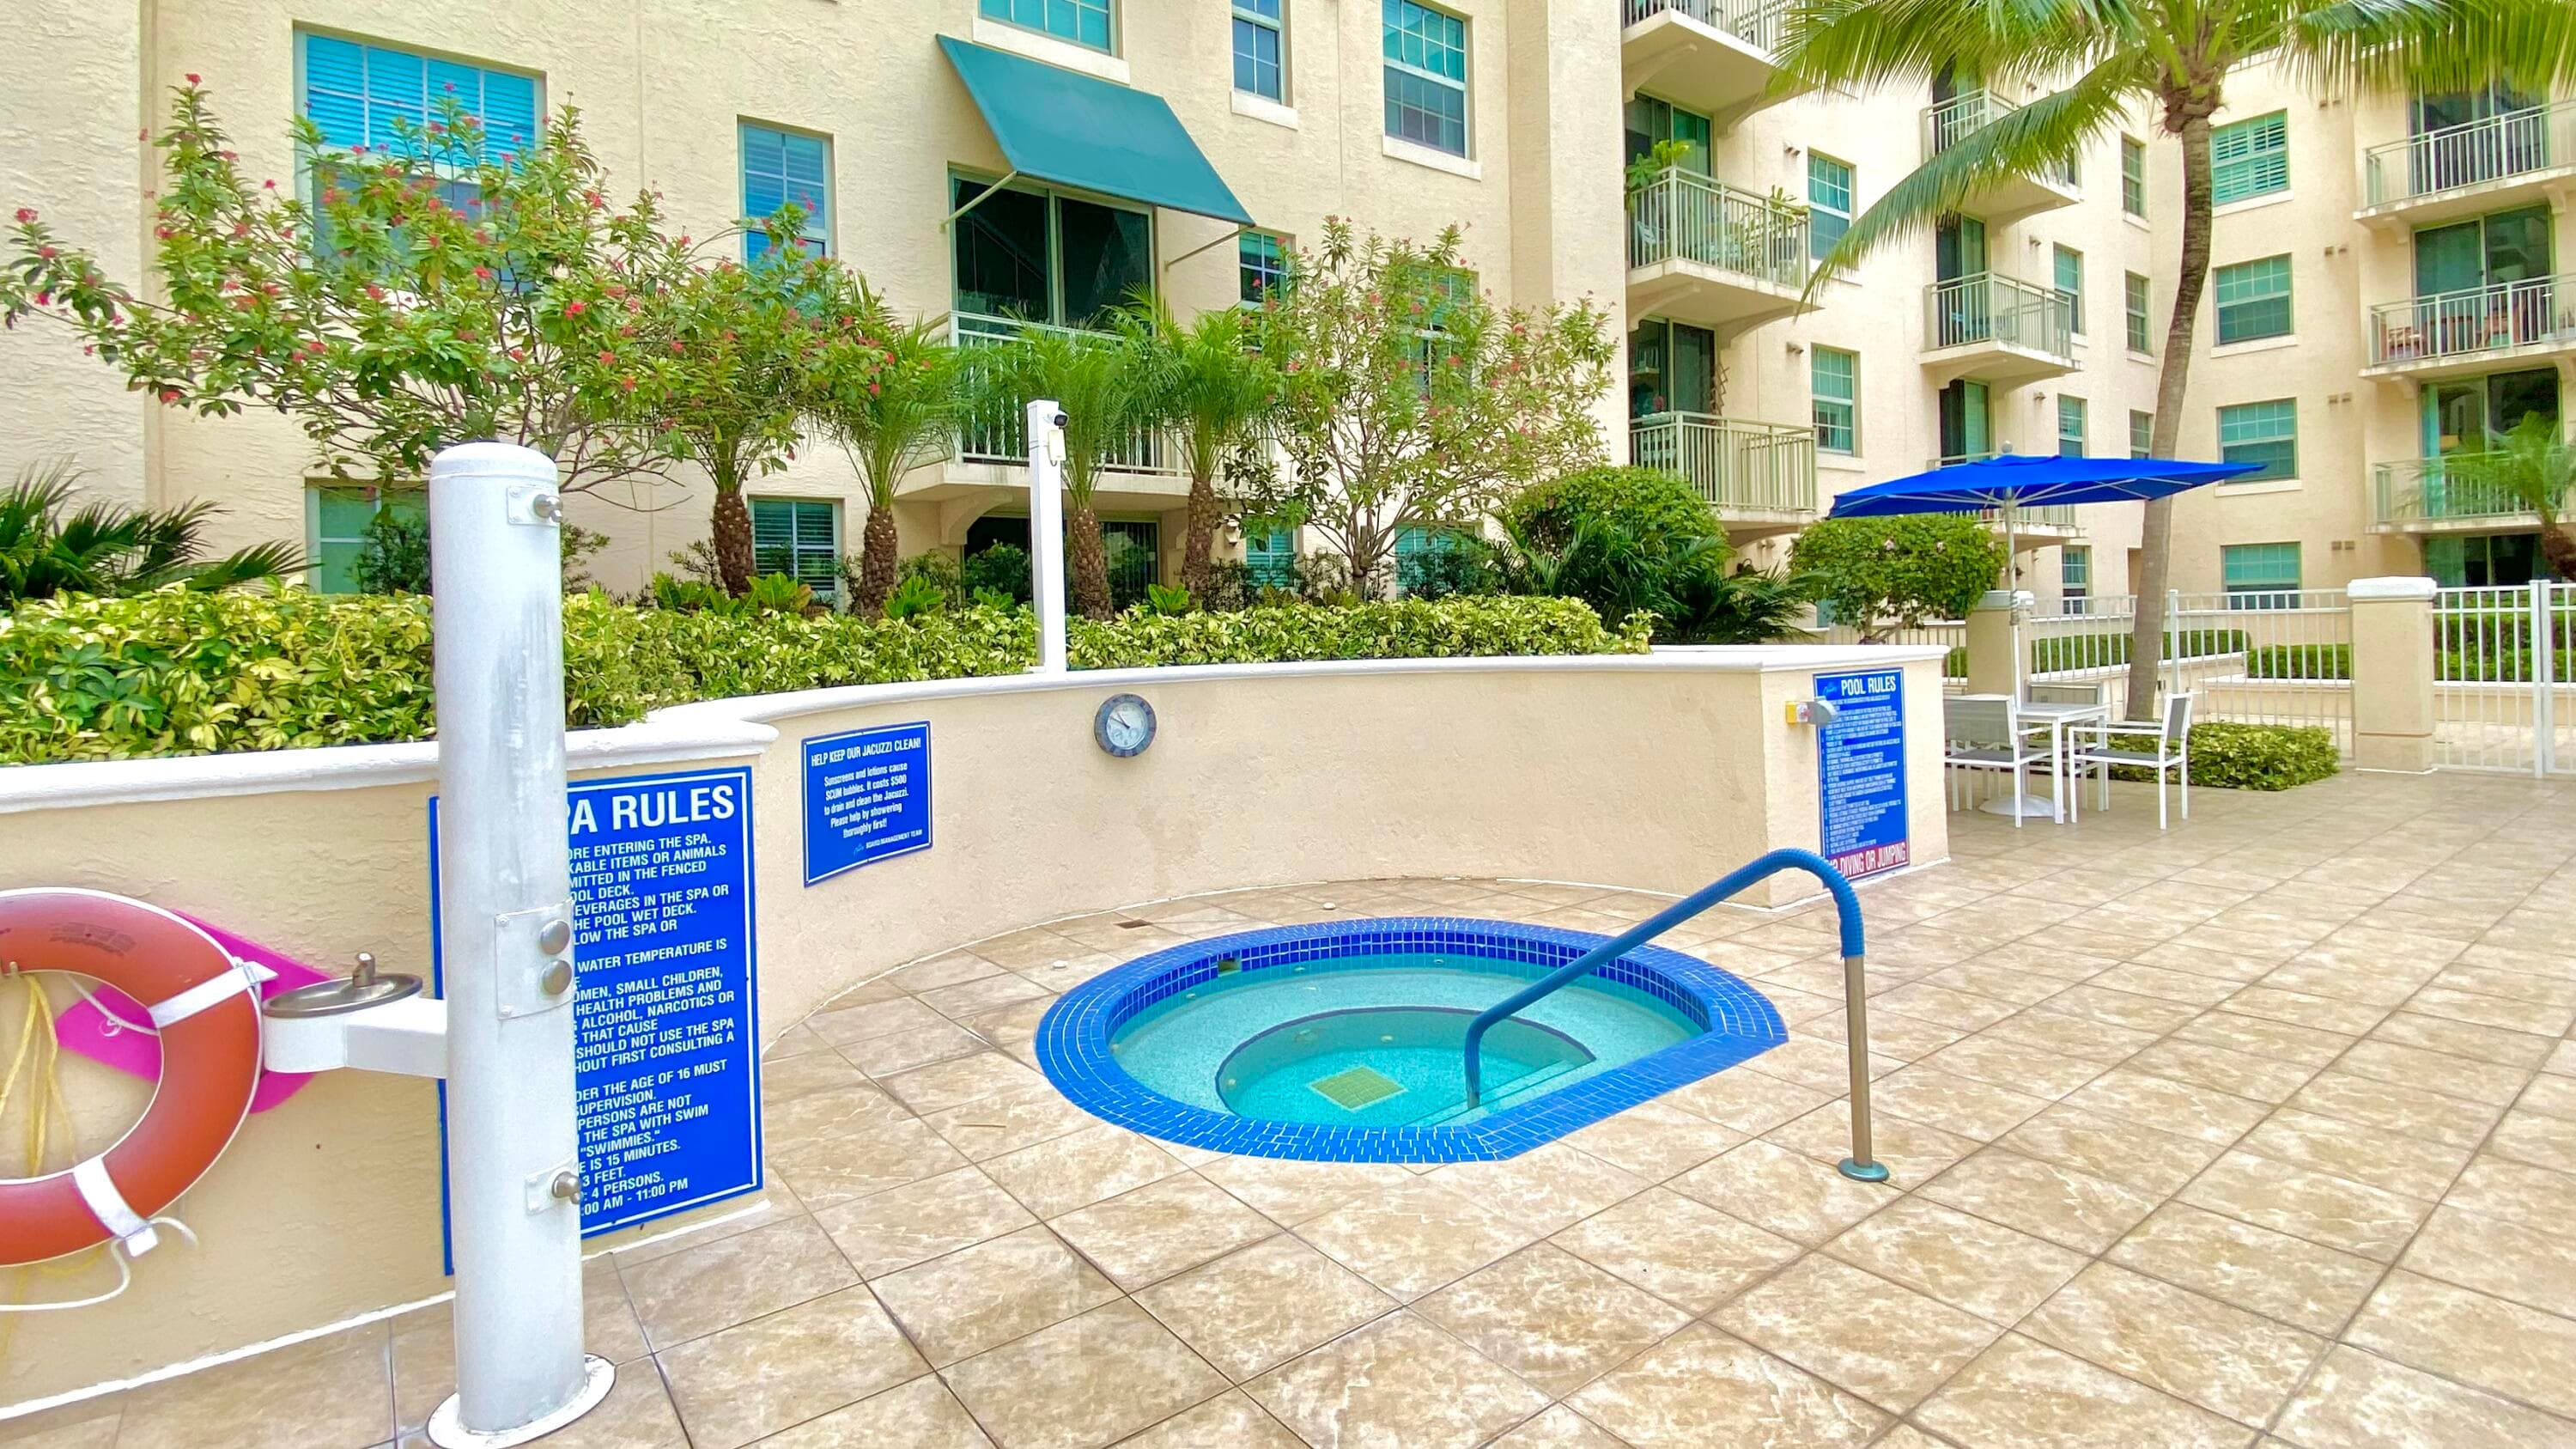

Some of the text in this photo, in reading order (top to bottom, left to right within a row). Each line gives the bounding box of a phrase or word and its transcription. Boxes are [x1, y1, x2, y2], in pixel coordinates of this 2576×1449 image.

[1841, 679, 1866, 696] POOL
[1868, 676, 1896, 693] RULES
[811, 738, 920, 766] HELP KEEP OUR JACUZZI CLEAN!
[856, 768, 866, 779] and
[867, 766, 887, 776] lotions
[889, 763, 908, 772] cause
[867, 781, 872, 790] It
[872, 778, 889, 789] costs
[891, 775, 907, 786] $500
[567, 785, 734, 835] A RULES
[824, 788, 908, 815] to drain and clean the Jacuzzi.
[830, 803, 902, 828] Please help by showering
[843, 822, 872, 838] thoroughly
[594, 840, 654, 857] ENTERING
[659, 837, 681, 849] THE
[685, 833, 711, 845] SPA.
[611, 854, 648, 869] ITEMS
[653, 852, 670, 863] OR
[673, 844, 726, 861] ANIMALS
[1840, 852, 1864, 876] DIVING
[1866, 849, 1876, 870] OR
[1878, 842, 1905, 868] JUMPING
[618, 871, 629, 882] IN
[634, 867, 657, 879] THE
[662, 861, 706, 877] FENCED
[575, 884, 729, 916] EVERAGES IN THE SPA OR
[598, 885, 634, 899] DECK.
[574, 904, 696, 931] HE POOL WET DECK.
[574, 919, 677, 945] LOW THE SPA OR
[577, 938, 726, 973] WATER TEMPERATURE IS
[617, 977, 658, 995] SMALL
[663, 966, 723, 987] CHILDREN,
[577, 979, 721, 1016] HEALTH PROBLEMS AND
[582, 1008, 642, 1030] ALCOHOL,
[647, 995, 714, 1018] NARCOTICS
[719, 990, 734, 1003] OR
[577, 1038, 627, 1059] SHOULD
[631, 1033, 655, 1049] NOT
[659, 1029, 682, 1043] USE
[686, 1023, 708, 1037] THE
[712, 1018, 734, 1032] SPA
[583, 1028, 613, 1044] THAT
[618, 1020, 658, 1036] CAUSE
[611, 1049, 647, 1067] FIRST
[650, 1033, 723, 1059] CONSULTING
[726, 1031, 734, 1042] A
[603, 1081, 626, 1096] THE
[631, 1075, 654, 1091] AGE
[659, 1073, 673, 1085] OF
[677, 1068, 690, 1081] 16
[694, 1059, 727, 1076] MUST
[578, 1094, 692, 1130] PERSONS ARE NOT
[584, 1128, 608, 1143] THE
[612, 1122, 636, 1136] SPA
[640, 1112, 671, 1129] WITH
[676, 1104, 709, 1122] SWIM
[580, 1129, 660, 1158] "SWIMMIES."
[580, 1139, 680, 1173] E IS 15 MINUTES.
[583, 1166, 626, 1187] 3 FEET.
[592, 1186, 599, 1199] 4
[604, 1171, 664, 1196] PERSONS.
[604, 1195, 623, 1210] AM
[635, 1185, 665, 1202] 11:00
[670, 1178, 688, 1193] PM
